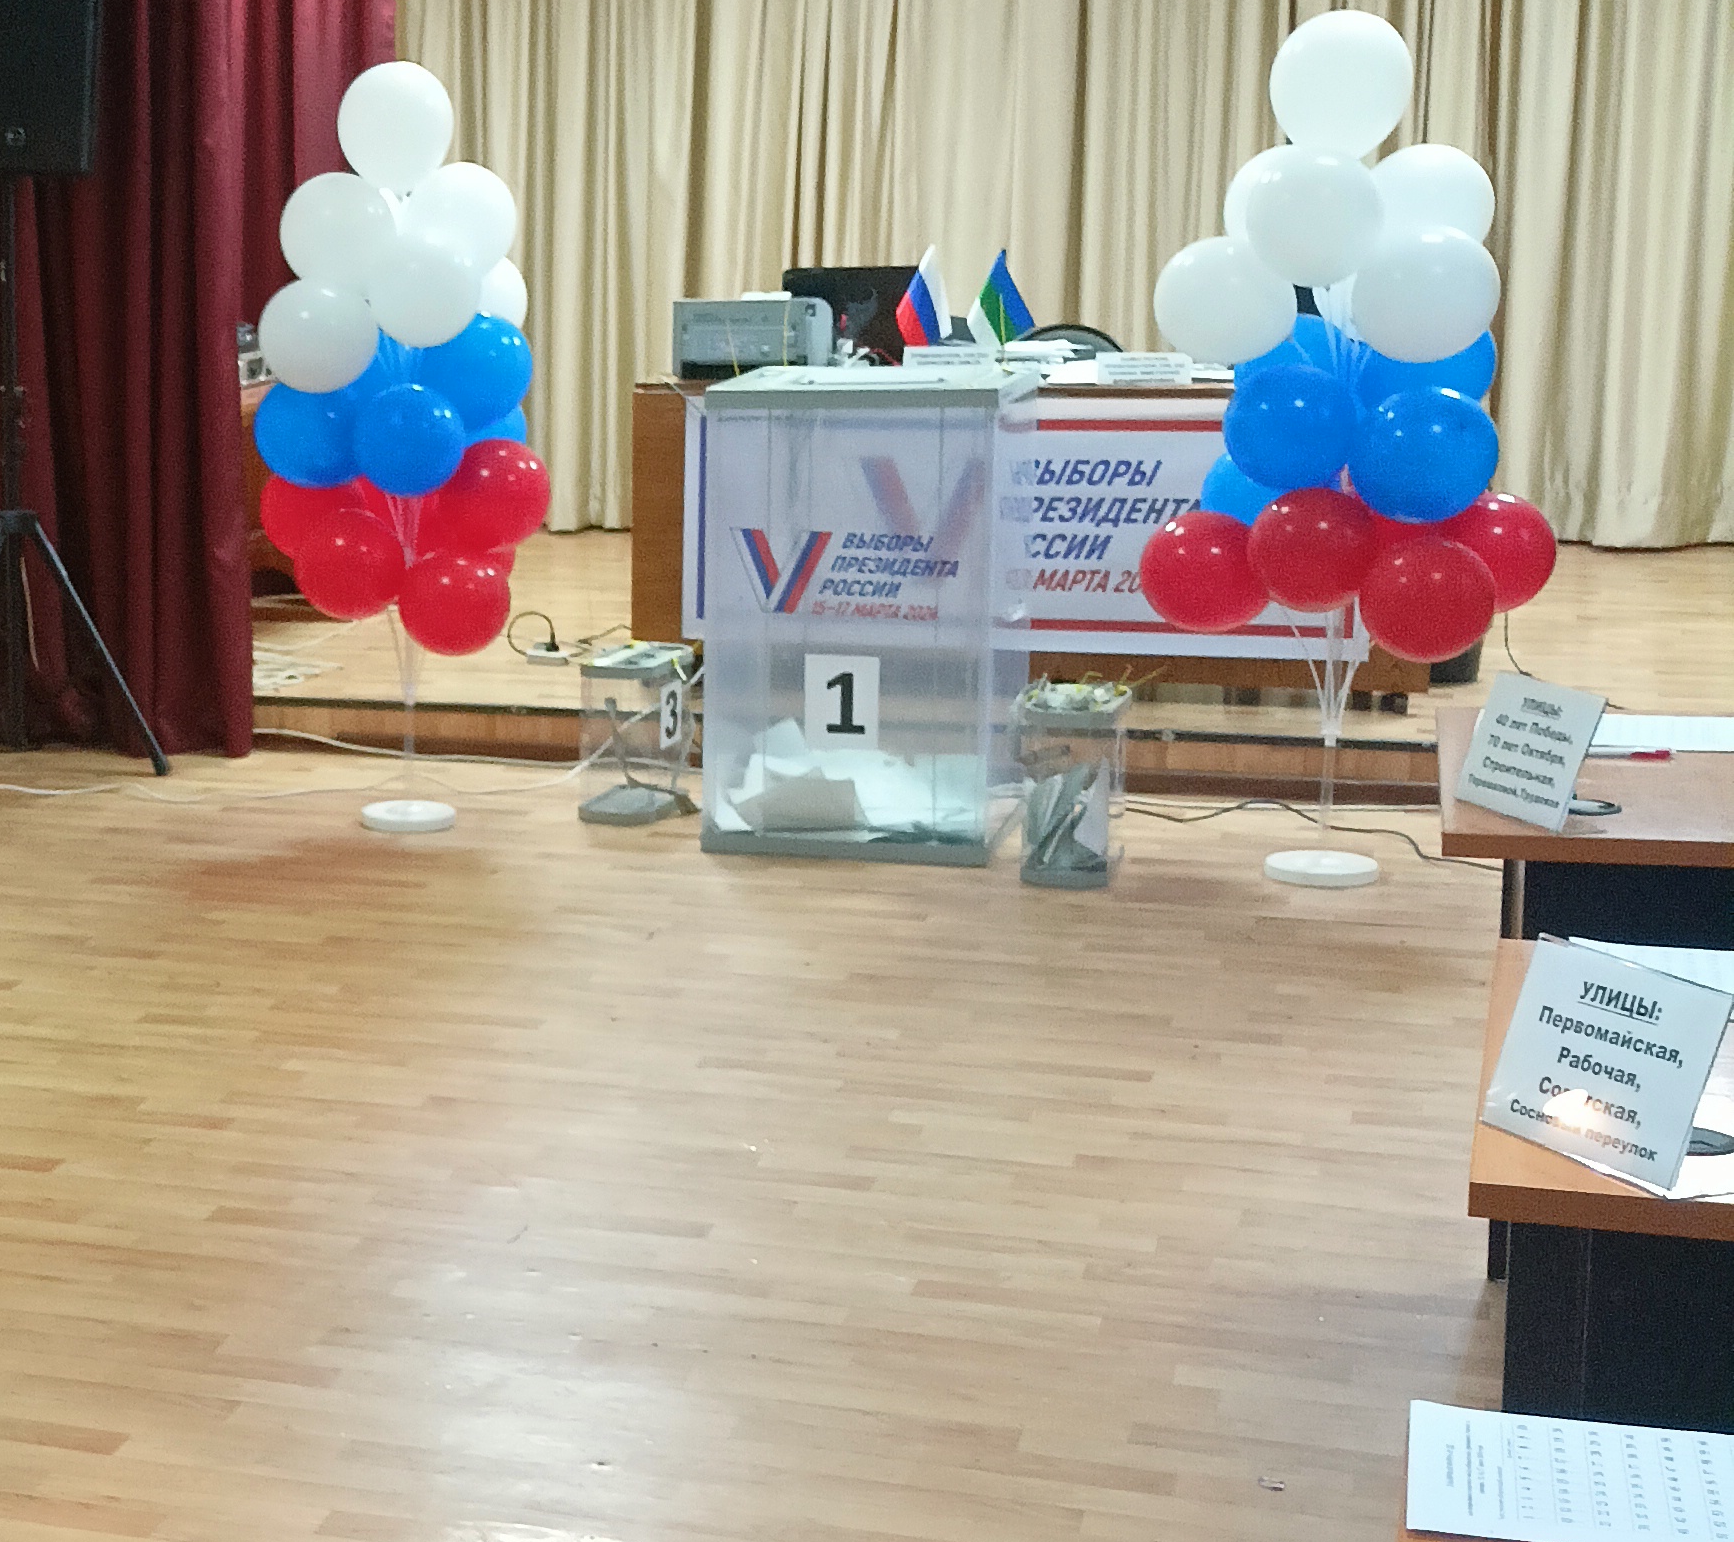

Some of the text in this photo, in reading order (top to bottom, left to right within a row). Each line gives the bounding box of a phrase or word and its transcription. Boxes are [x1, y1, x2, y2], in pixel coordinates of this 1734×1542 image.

[1033, 458, 1163, 487] ЫБОРЫ
[1032, 496, 1201, 528] РЕЗИДЕНТ
[842, 532, 934, 553] ВЫБОРЫ
[1030, 533, 1114, 562] ССИИ
[830, 555, 959, 577] ПРЕЗИДЕНТА
[1032, 568, 1111, 593] МАРТА
[818, 578, 902, 599] РОССИИ
[665, 689, 678, 739] 3
[826, 672, 866, 735] 1
[1580, 981, 1663, 1021] УЛИЦЫ:
[1539, 1005, 1684, 1069] Первомайская,
[1557, 1046, 1641, 1092] Рабочая,
[1539, 1076, 1641, 1129] Сотская,
[1585, 1128, 1658, 1161] переулок
